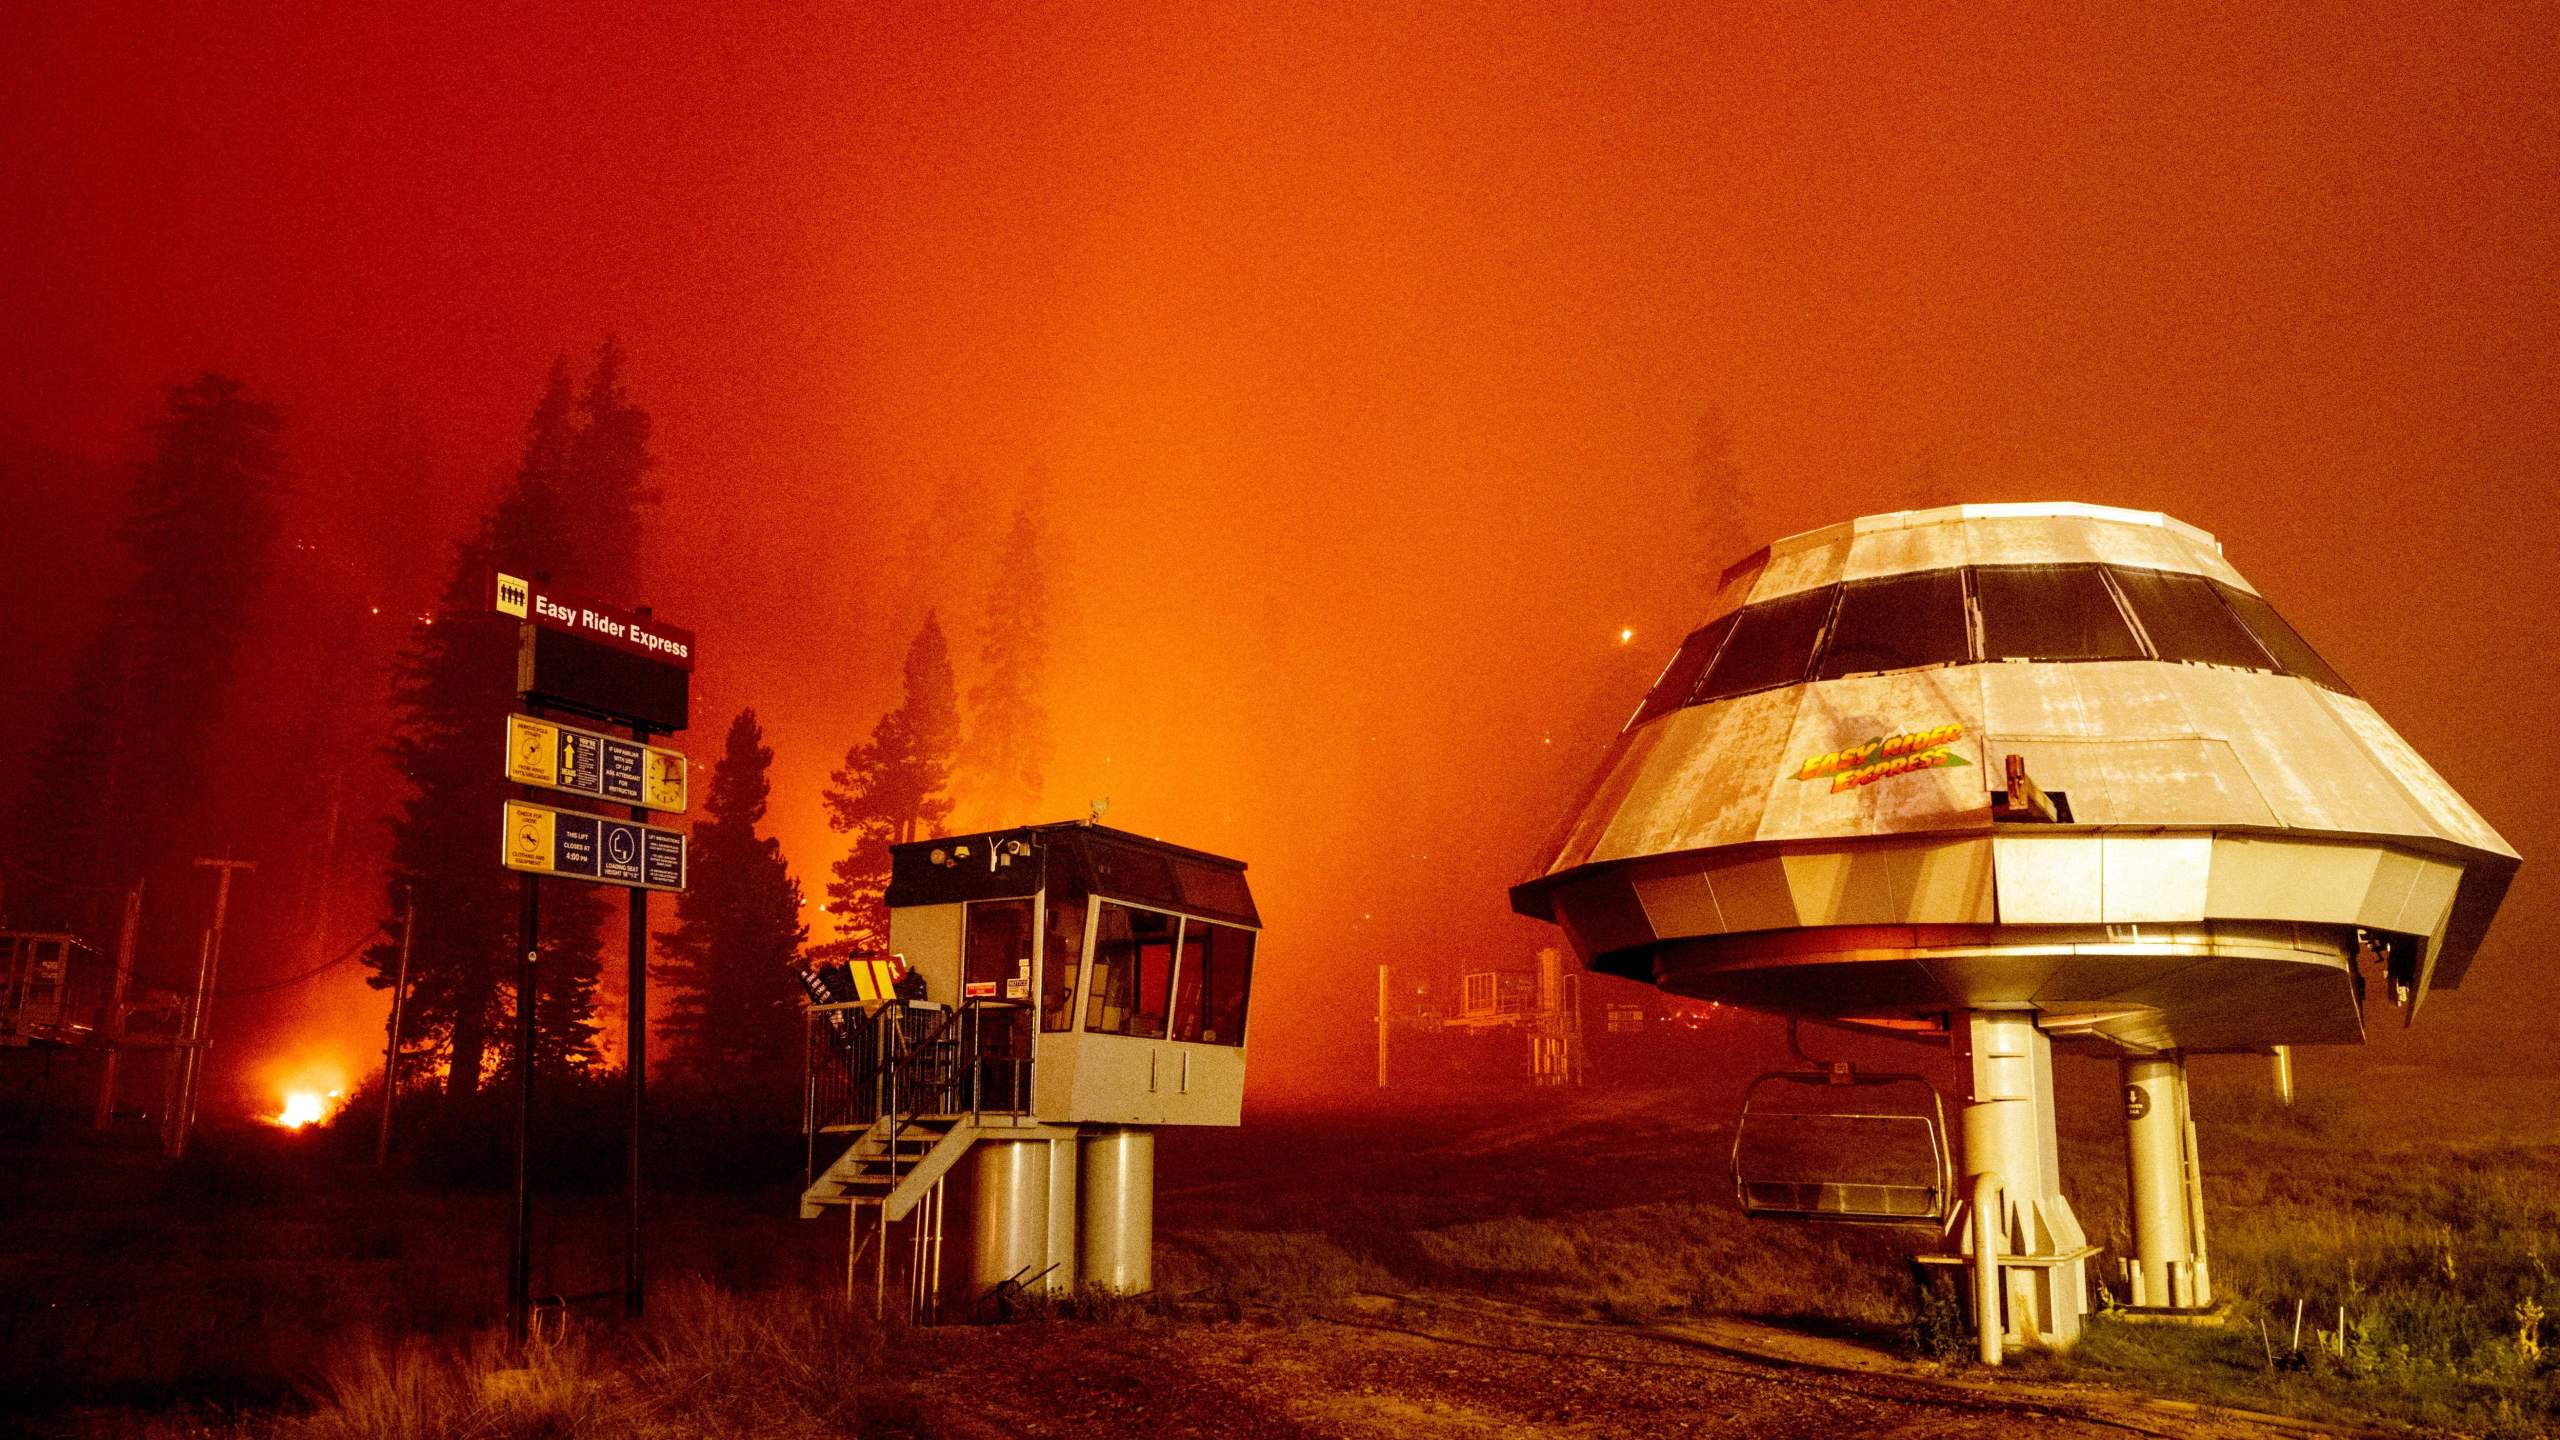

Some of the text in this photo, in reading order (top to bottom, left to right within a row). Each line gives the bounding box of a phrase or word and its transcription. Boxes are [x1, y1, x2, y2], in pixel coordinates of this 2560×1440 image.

[536, 595, 688, 658] Easy Rider Express
[1798, 722, 1964, 781] EASY RIDER
[616, 772, 640, 782] ATTENDANT
[1831, 747, 1950, 794] EXPRESS
[564, 842, 584, 850] CLOSES
[566, 852, 580, 860] 4:00
